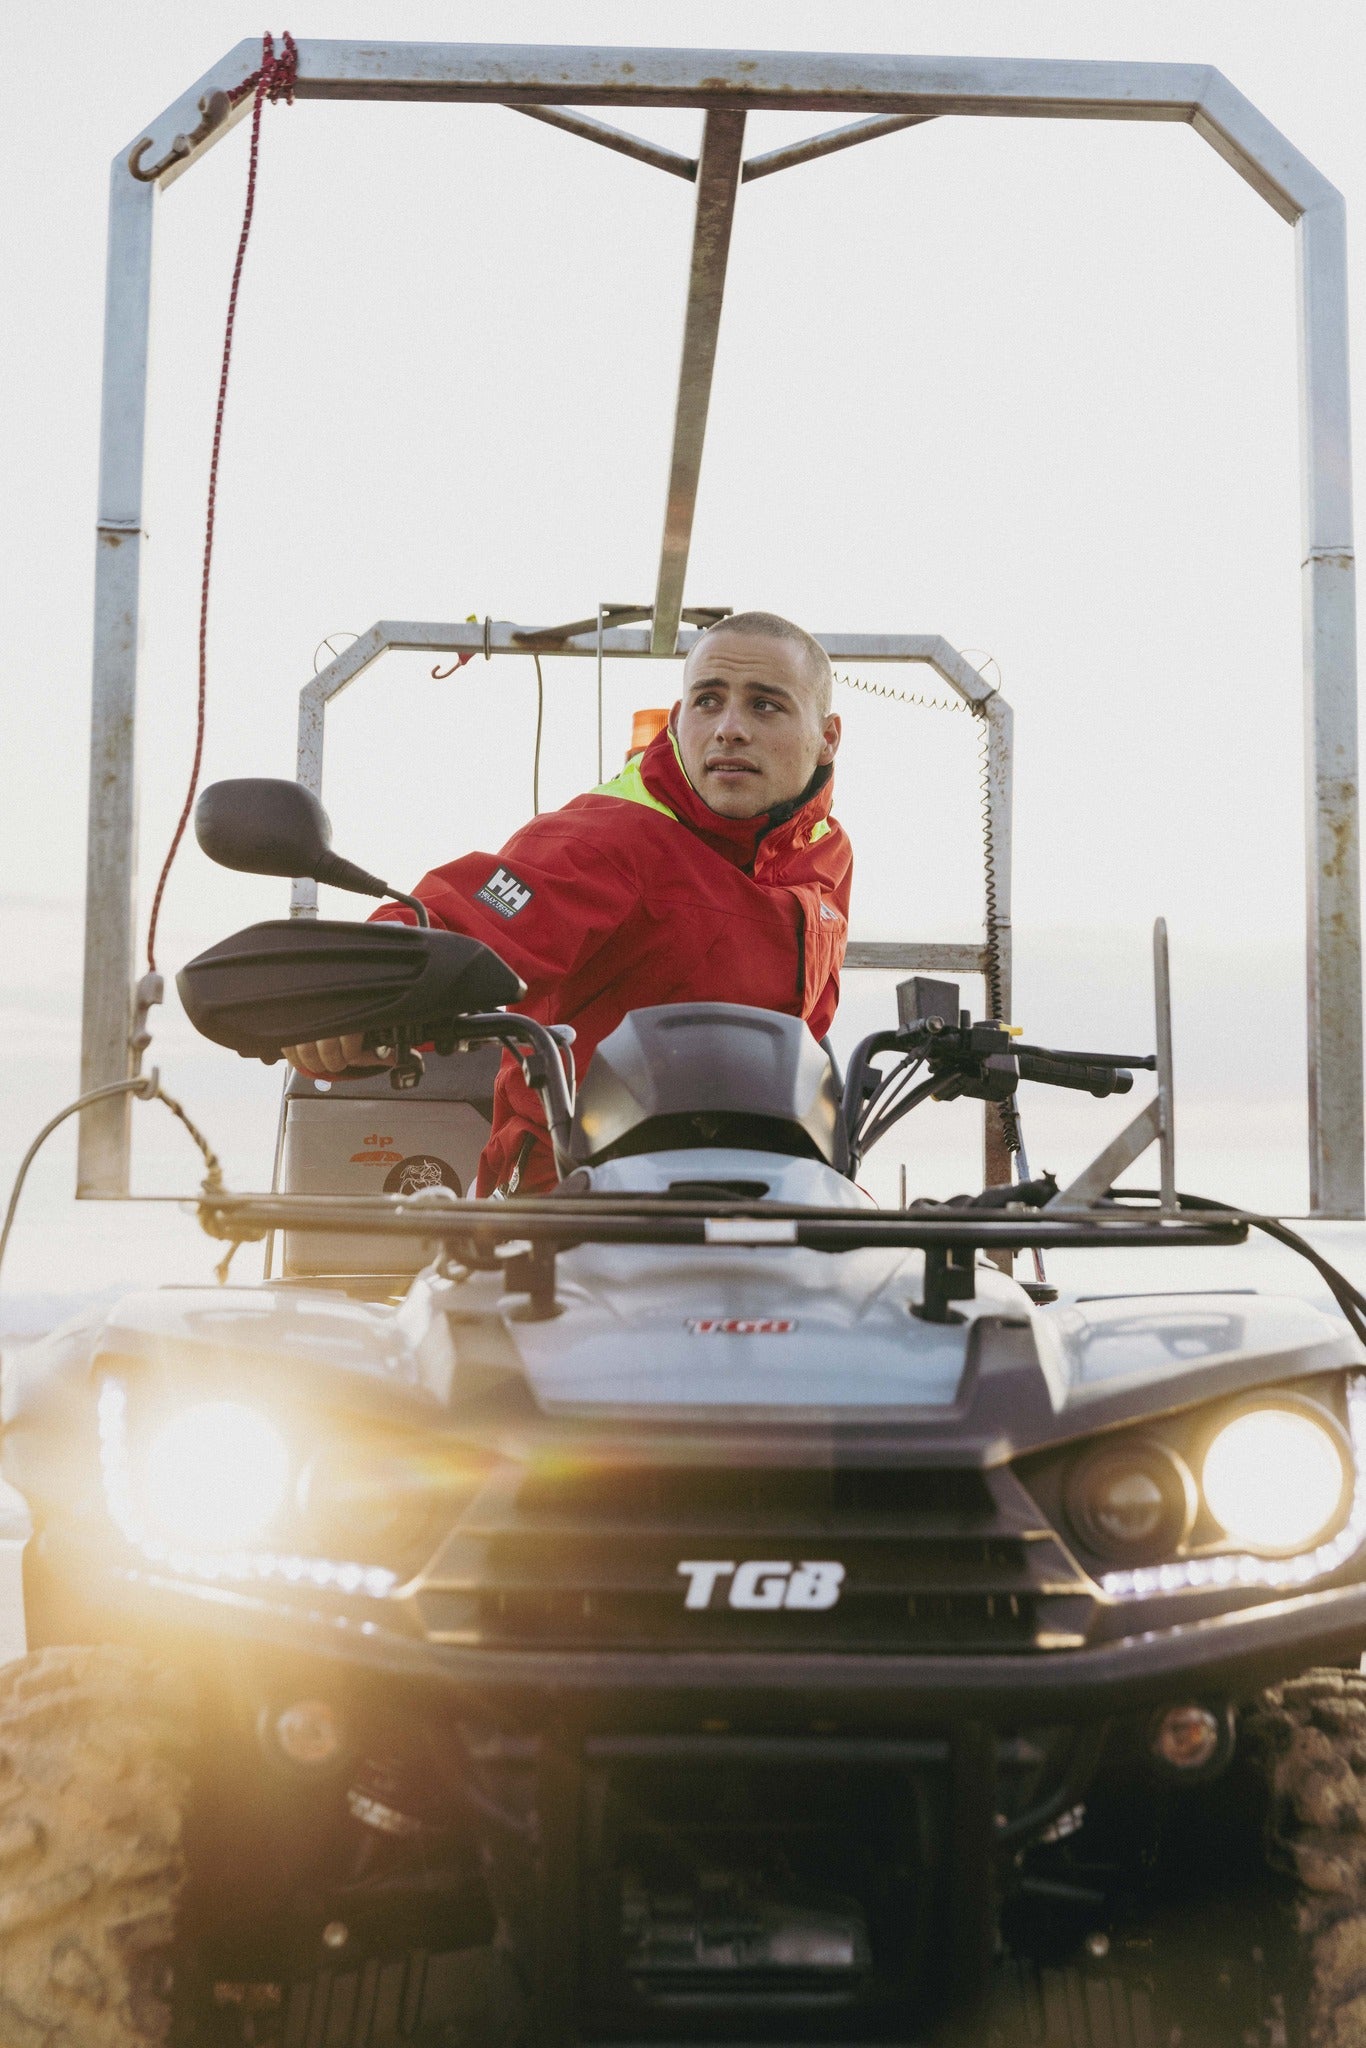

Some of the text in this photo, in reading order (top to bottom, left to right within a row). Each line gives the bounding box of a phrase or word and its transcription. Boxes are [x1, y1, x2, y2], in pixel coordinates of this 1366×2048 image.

[486, 868, 532, 911] HH
[363, 1133, 394, 1148] dp
[676, 1560, 845, 1610] TGB
